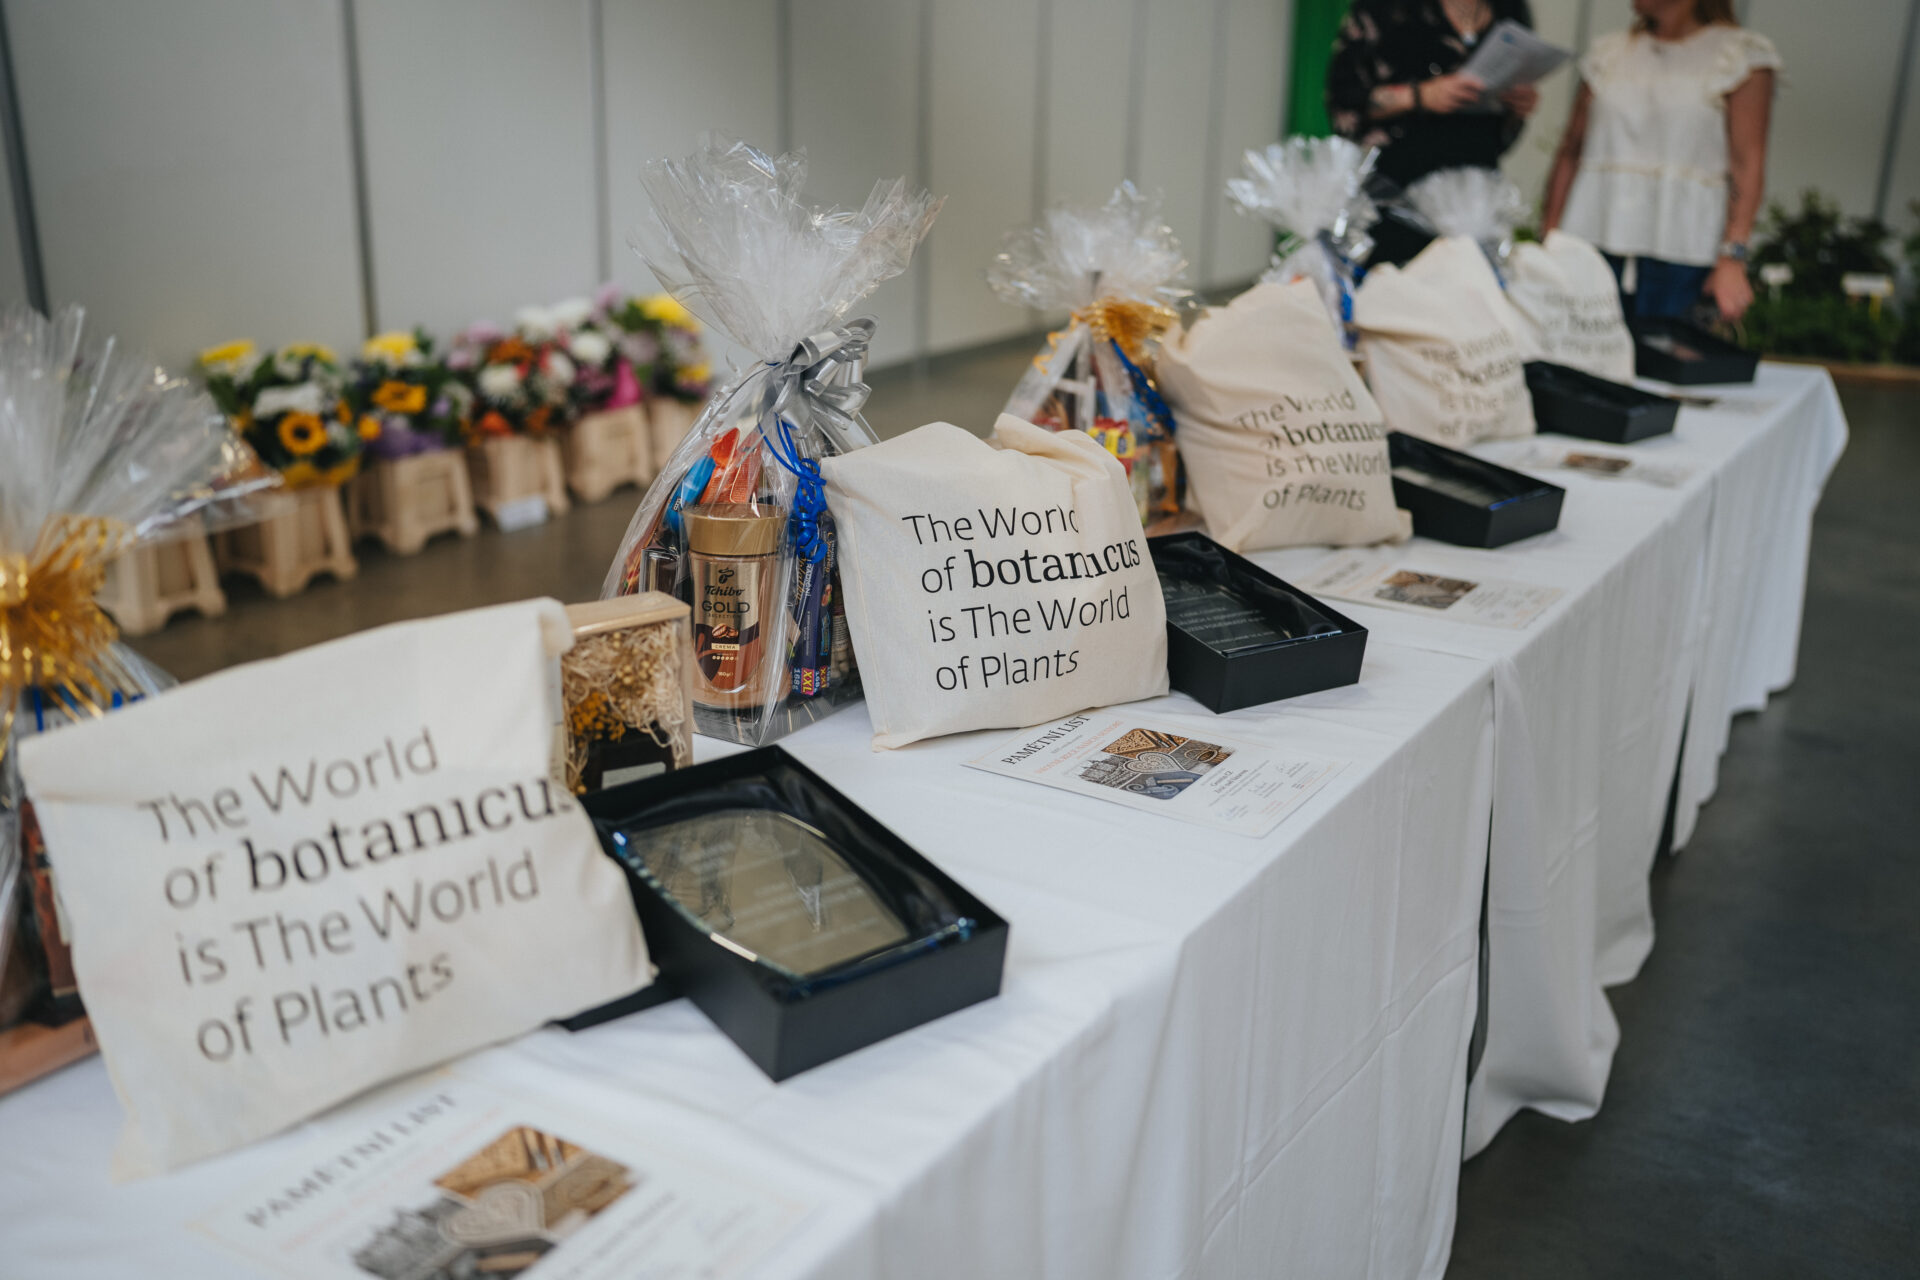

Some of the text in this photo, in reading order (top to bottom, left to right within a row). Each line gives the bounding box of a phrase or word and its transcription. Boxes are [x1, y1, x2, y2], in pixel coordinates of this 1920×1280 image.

[1235, 403, 1286, 430] The
[1265, 454, 1287, 478] is
[1295, 451, 1339, 476] The
[1263, 483, 1366, 511] of Plants
[902, 511, 974, 545] The
[921, 537, 1141, 594] of botanicus
[701, 600, 751, 614] GOLD
[704, 584, 745, 597] Tchibo
[927, 609, 956, 643] is
[960, 604, 1032, 640] The
[1036, 585, 1131, 632] World
[802, 669, 813, 693] XXL
[936, 649, 1080, 692] of Plants
[1062, 714, 1091, 733] LIST
[138, 725, 440, 843] The World
[163, 853, 225, 909] of
[176, 850, 541, 987] is The World
[195, 952, 455, 1064] of Plants
